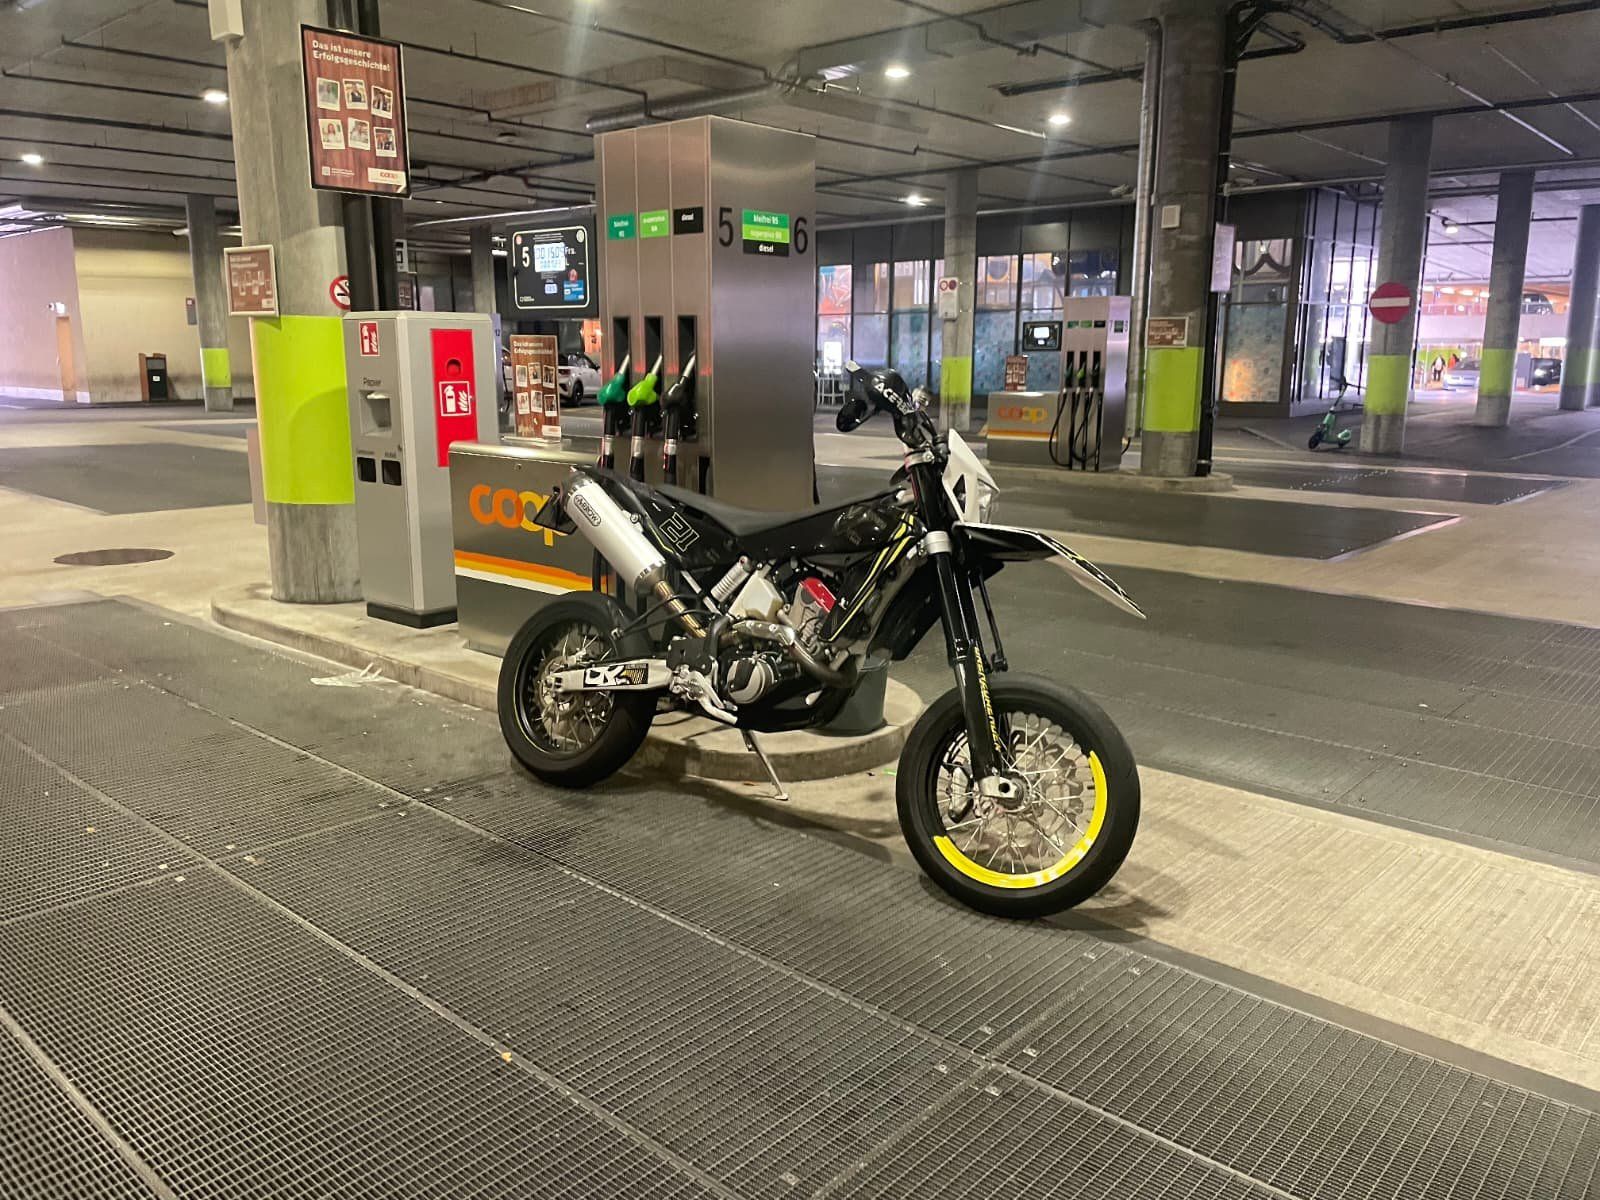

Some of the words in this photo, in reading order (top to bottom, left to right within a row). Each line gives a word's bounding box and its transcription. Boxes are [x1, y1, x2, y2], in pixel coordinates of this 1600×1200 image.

[312, 40, 328, 50] Das
[330, 43, 341, 52] ist
[343, 47, 371, 58] unsere
[719, 206, 734, 247] 5
[794, 216, 809, 255] 6
[522, 246, 530, 267] 5
